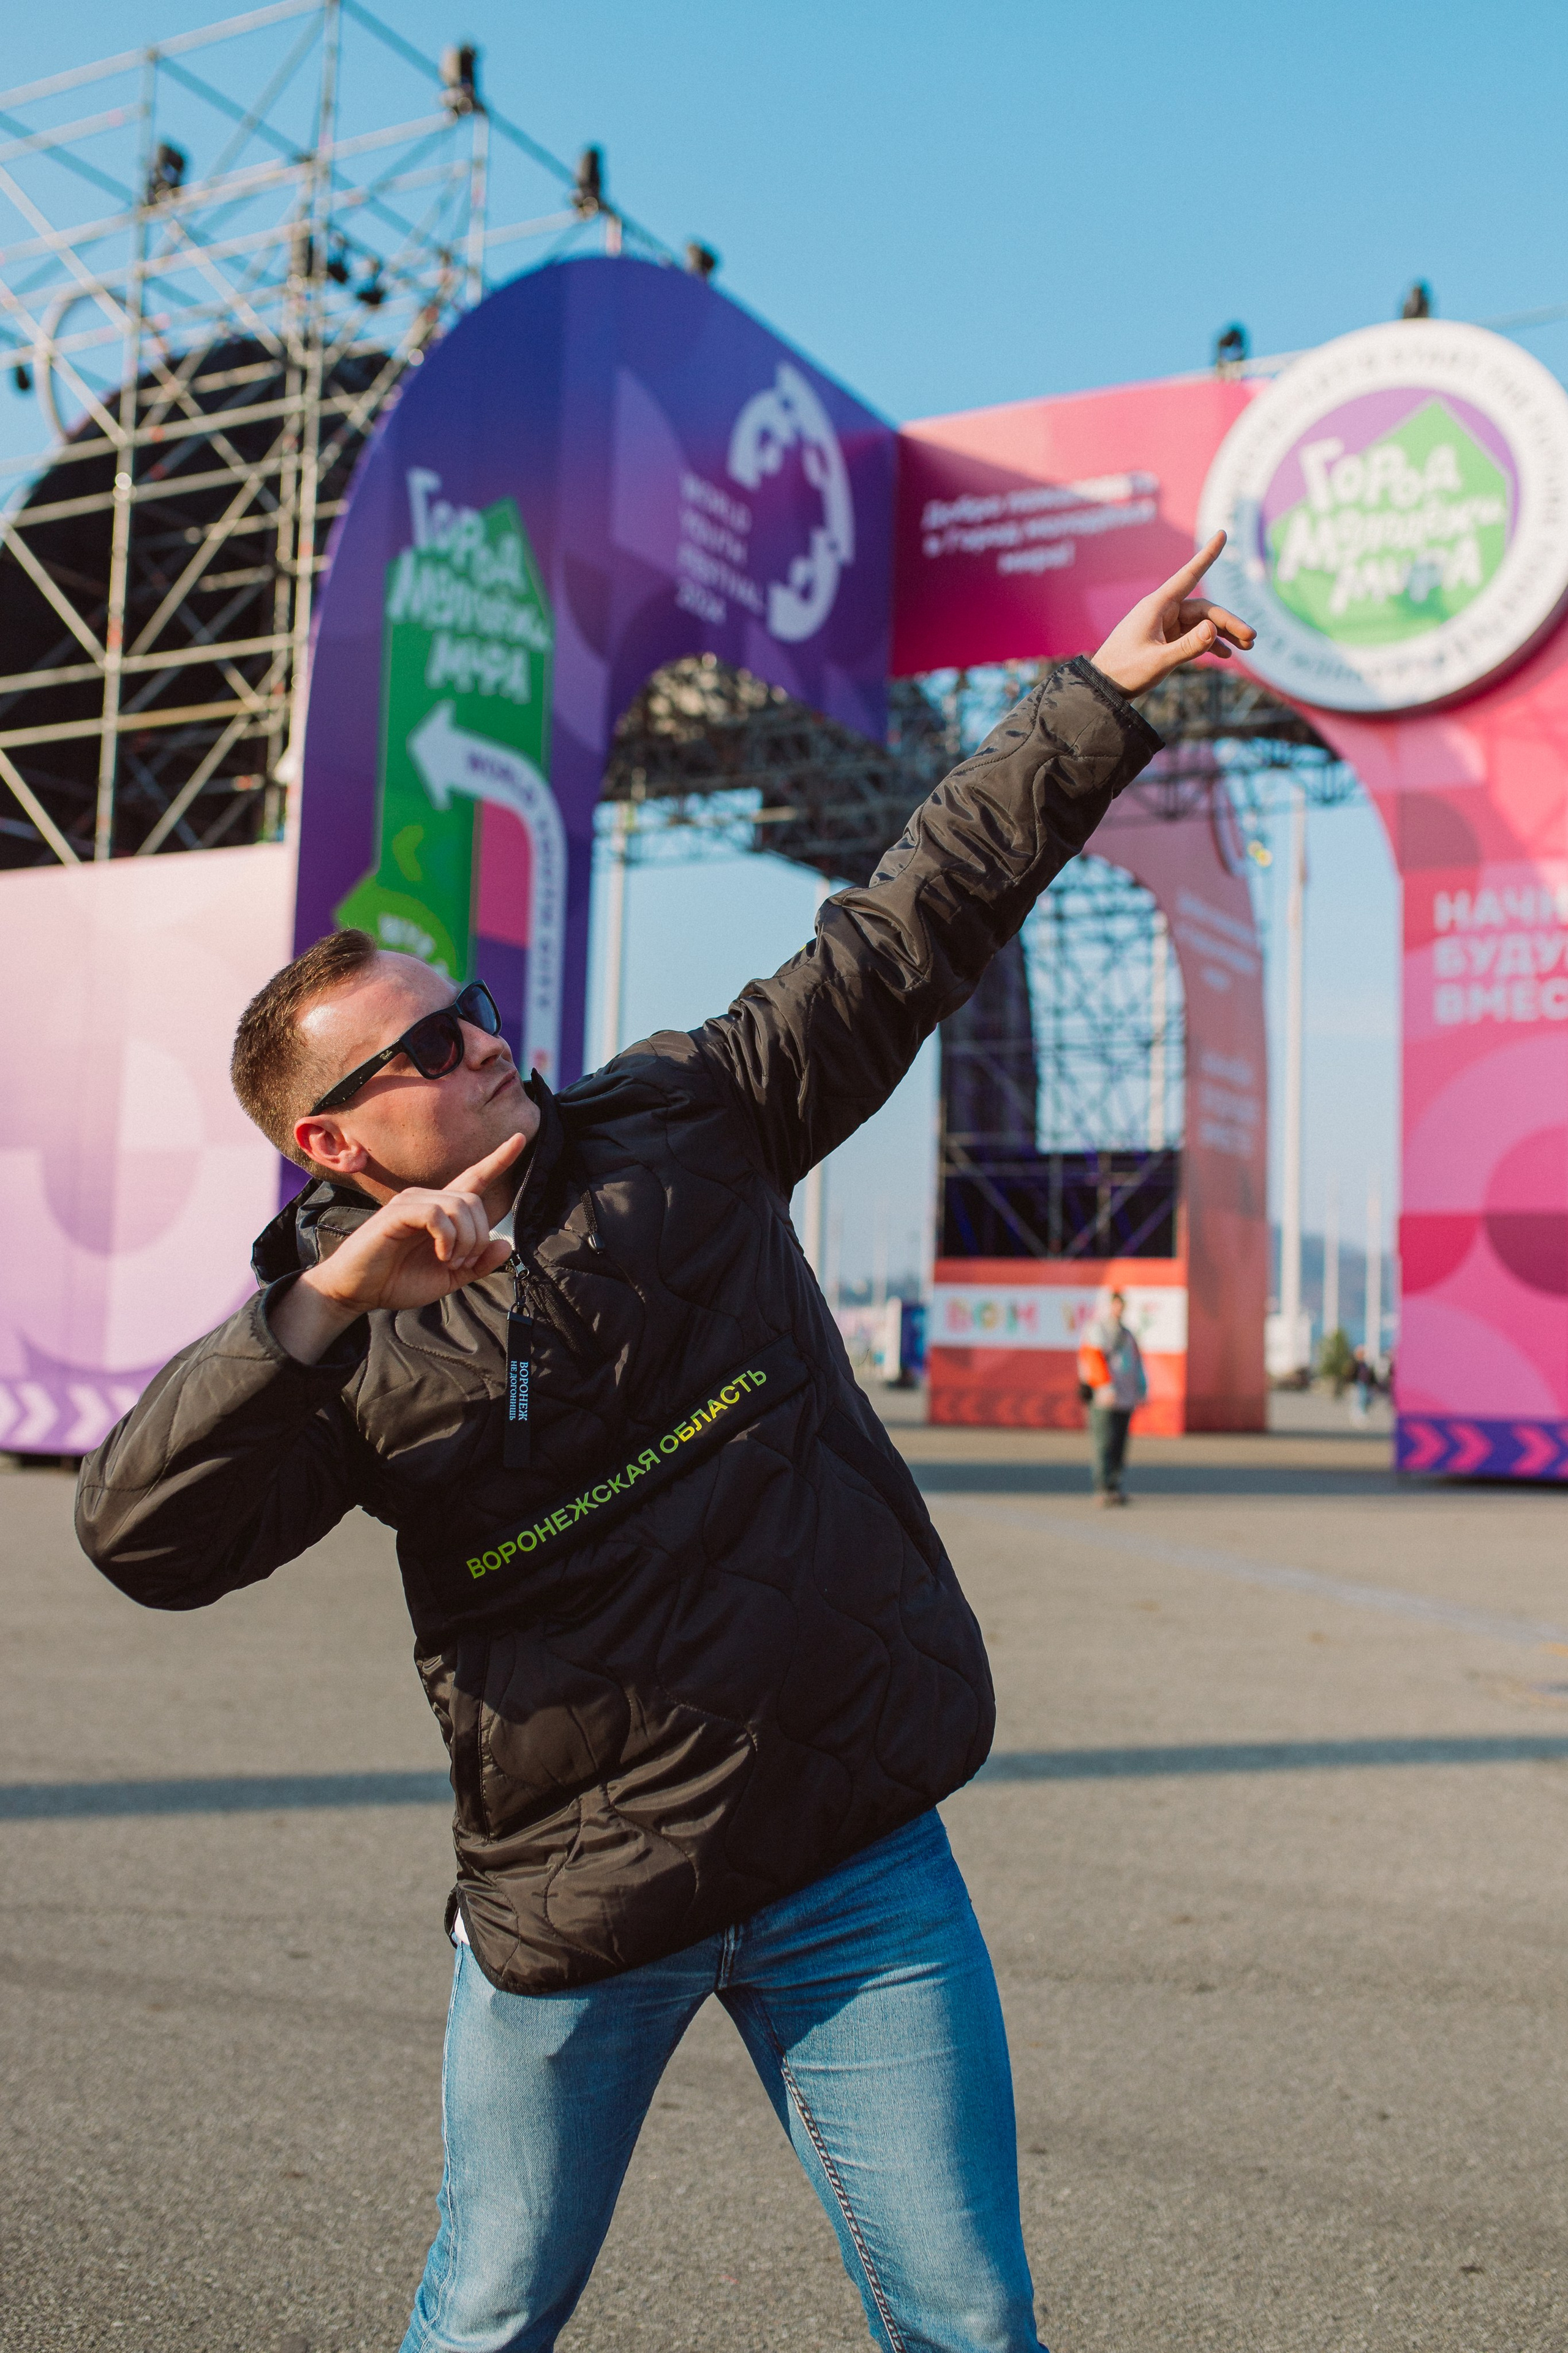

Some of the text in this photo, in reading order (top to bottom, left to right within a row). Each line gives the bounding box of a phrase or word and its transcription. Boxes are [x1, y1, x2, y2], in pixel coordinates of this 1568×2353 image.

[1434, 932, 1568, 979] БУДУ
[511, 1361, 518, 1372] НЕ
[518, 1361, 529, 1421] ВОРОНЕЖ
[466, 1369, 767, 1579] ВОРОНЕЖСКАЯ ОБЛАСТЬ
